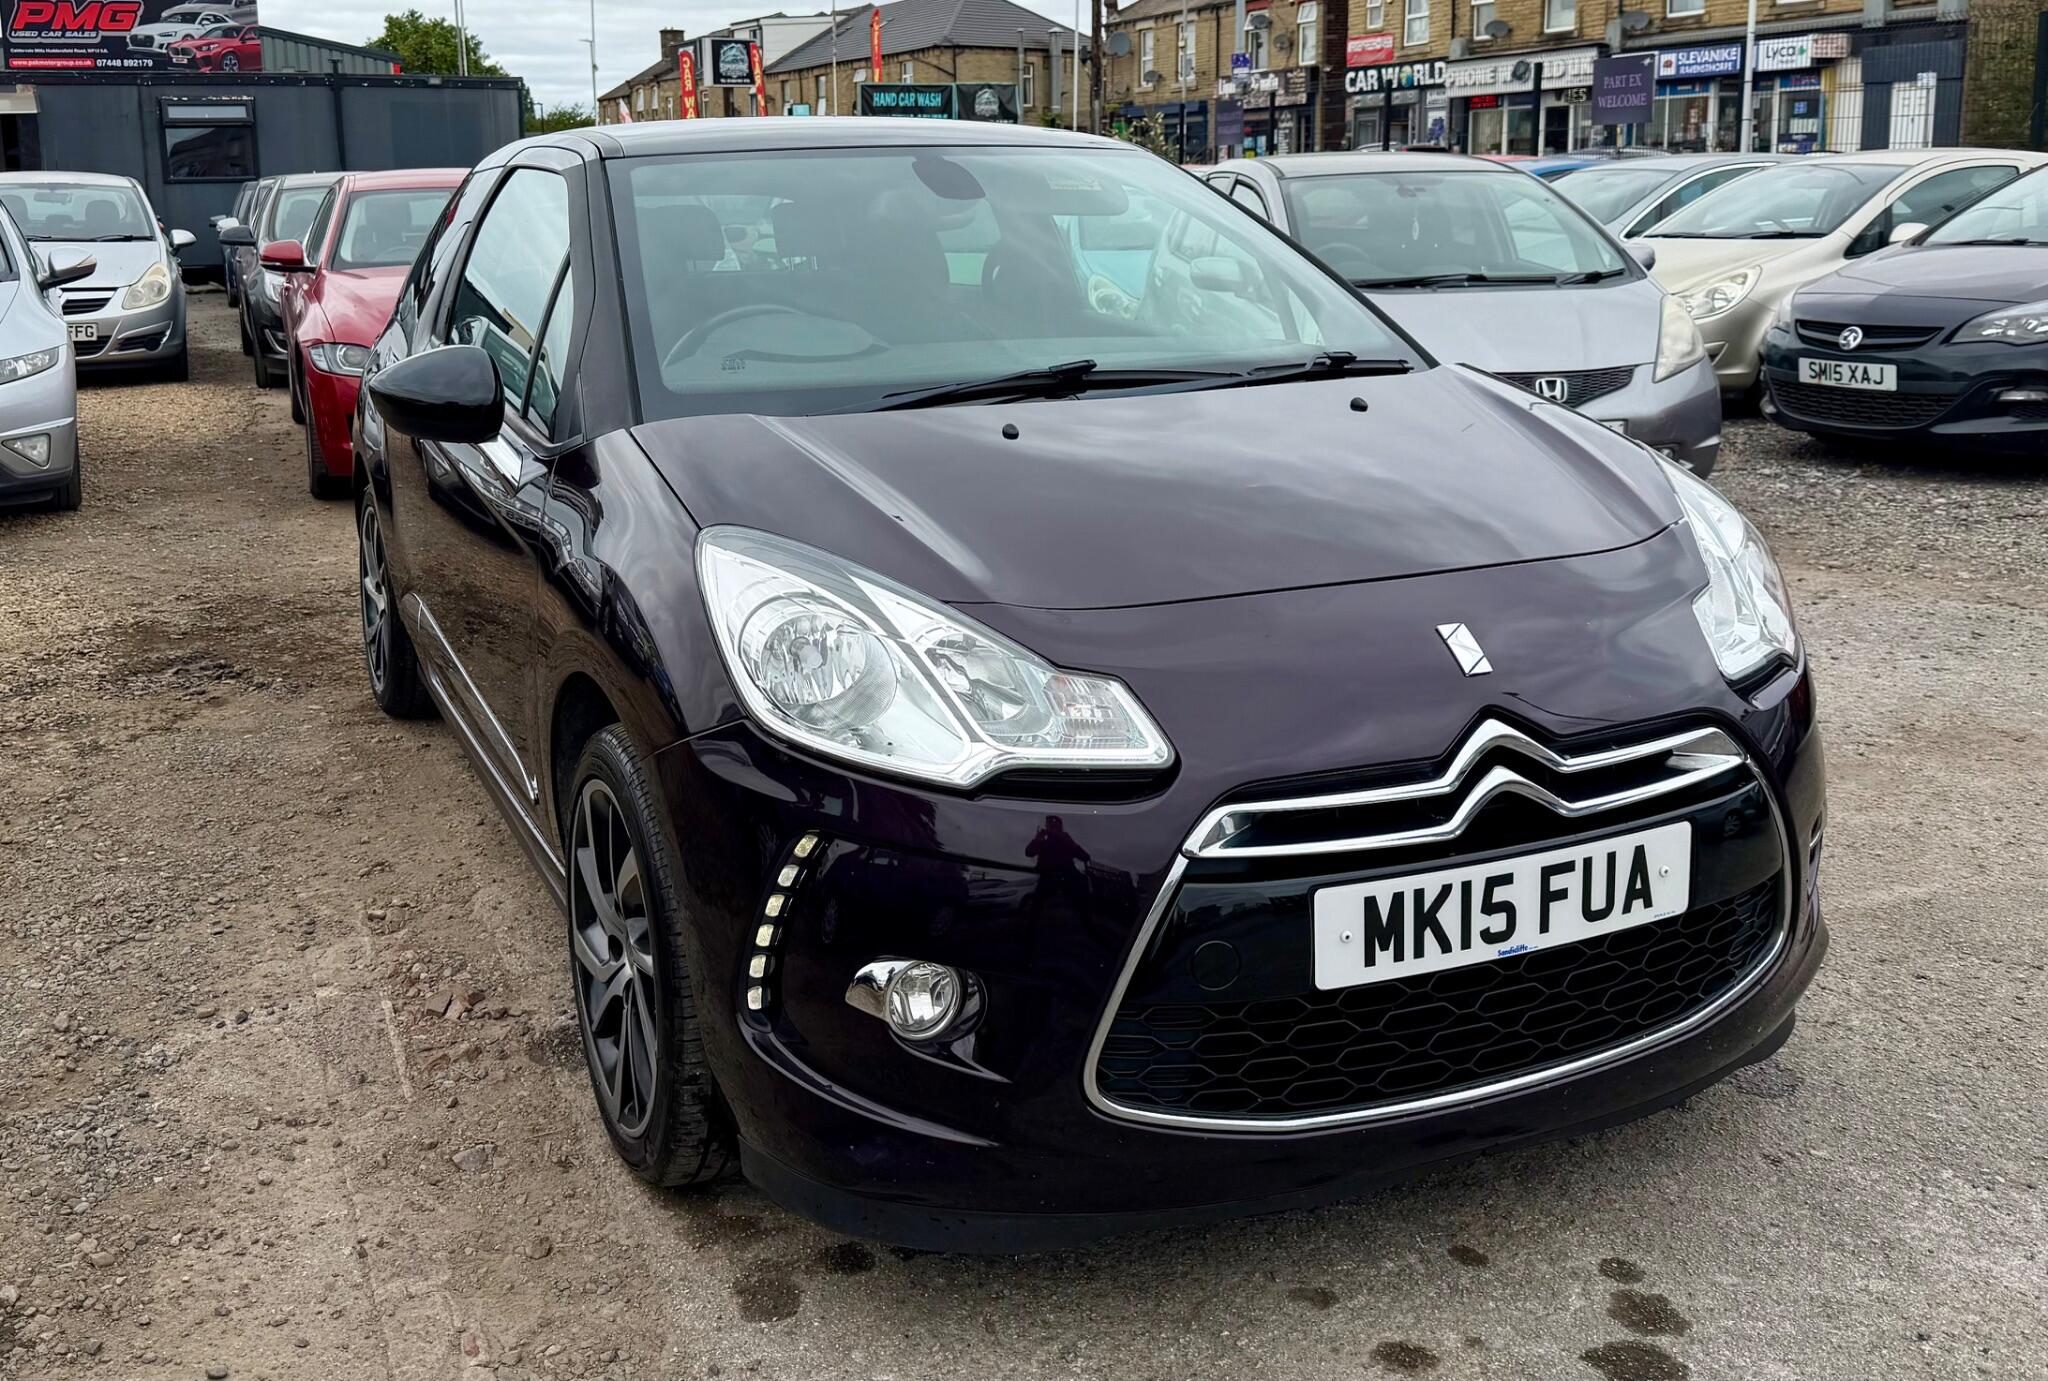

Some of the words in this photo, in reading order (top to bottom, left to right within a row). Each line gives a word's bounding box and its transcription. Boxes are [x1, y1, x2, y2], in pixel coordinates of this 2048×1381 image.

[13, 1, 141, 31] PMG
[1345, 69, 1378, 93] CAR
[1604, 75, 1626, 89] PART
[1628, 73, 1643, 87] EX
[872, 92, 897, 107] HAND
[898, 92, 915, 107] CAR
[917, 92, 942, 107] WASH
[1598, 93, 1647, 108] WELCOME
[1808, 361, 1843, 382] SM15
[1848, 364, 1884, 385] XAJ
[1363, 872, 1517, 968] MK15
[1539, 844, 1654, 935] FUA
